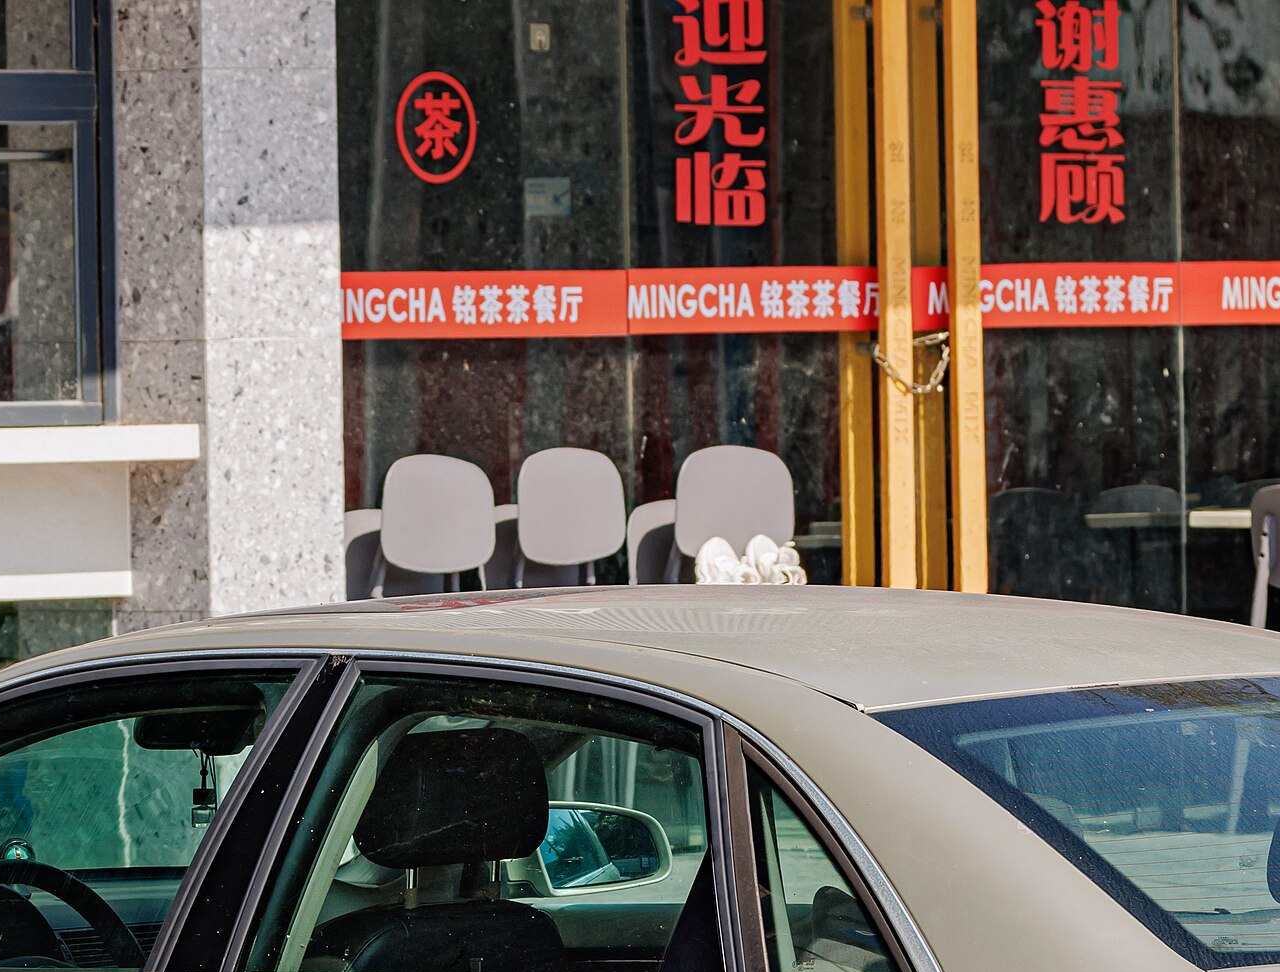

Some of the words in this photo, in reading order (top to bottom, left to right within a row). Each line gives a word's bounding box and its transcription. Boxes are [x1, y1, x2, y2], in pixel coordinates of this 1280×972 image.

[414, 92, 462, 160] 茶
[672, 0, 767, 227] 迎光临
[1036, 0, 1127, 225] 谢惠顾
[451, 284, 584, 325] 铭茶茶餐厅
[628, 282, 755, 320] MINGCHA
[760, 279, 880, 320] 铭茶茶餐厅
[1054, 275, 1174, 315] 铭茶茶餐厅
